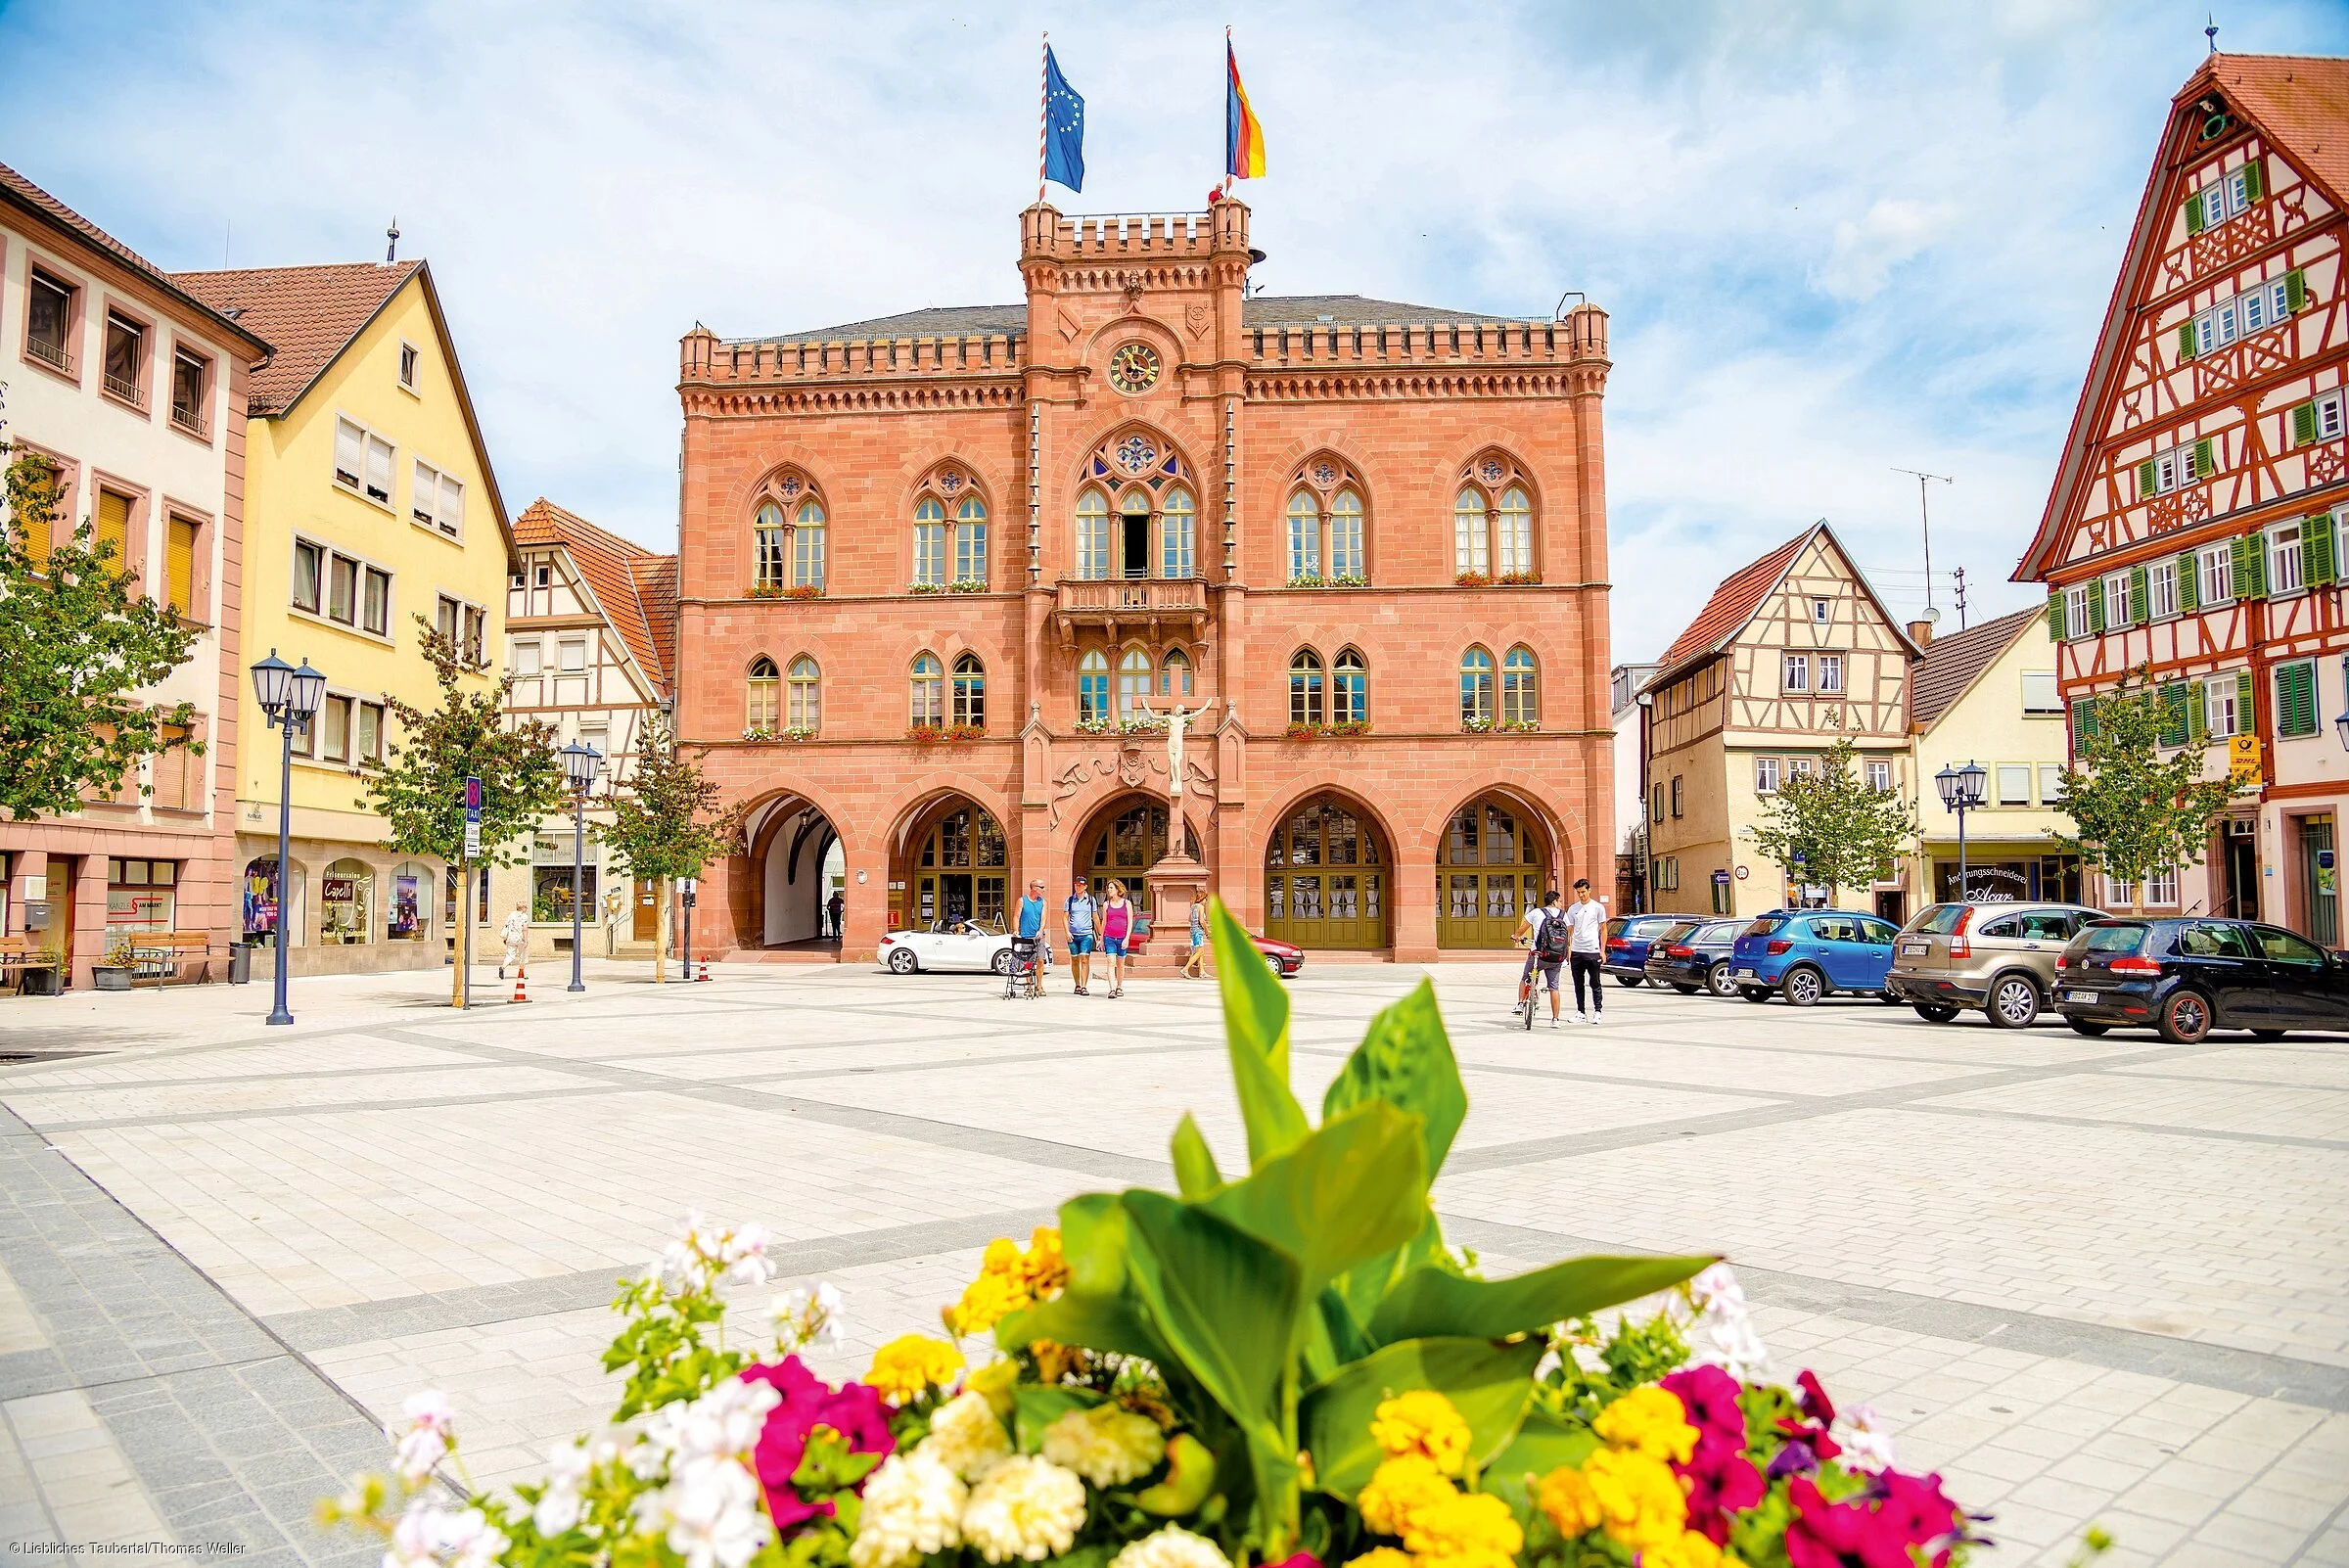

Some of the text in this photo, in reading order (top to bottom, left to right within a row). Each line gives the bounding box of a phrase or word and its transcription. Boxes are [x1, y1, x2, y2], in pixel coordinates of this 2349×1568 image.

[468, 808, 480, 819] TAXI
[326, 870, 361, 879] Friseursalon
[1947, 867, 2028, 886] Ändrungsschneiderei
[325, 882, 351, 900] Capelli
